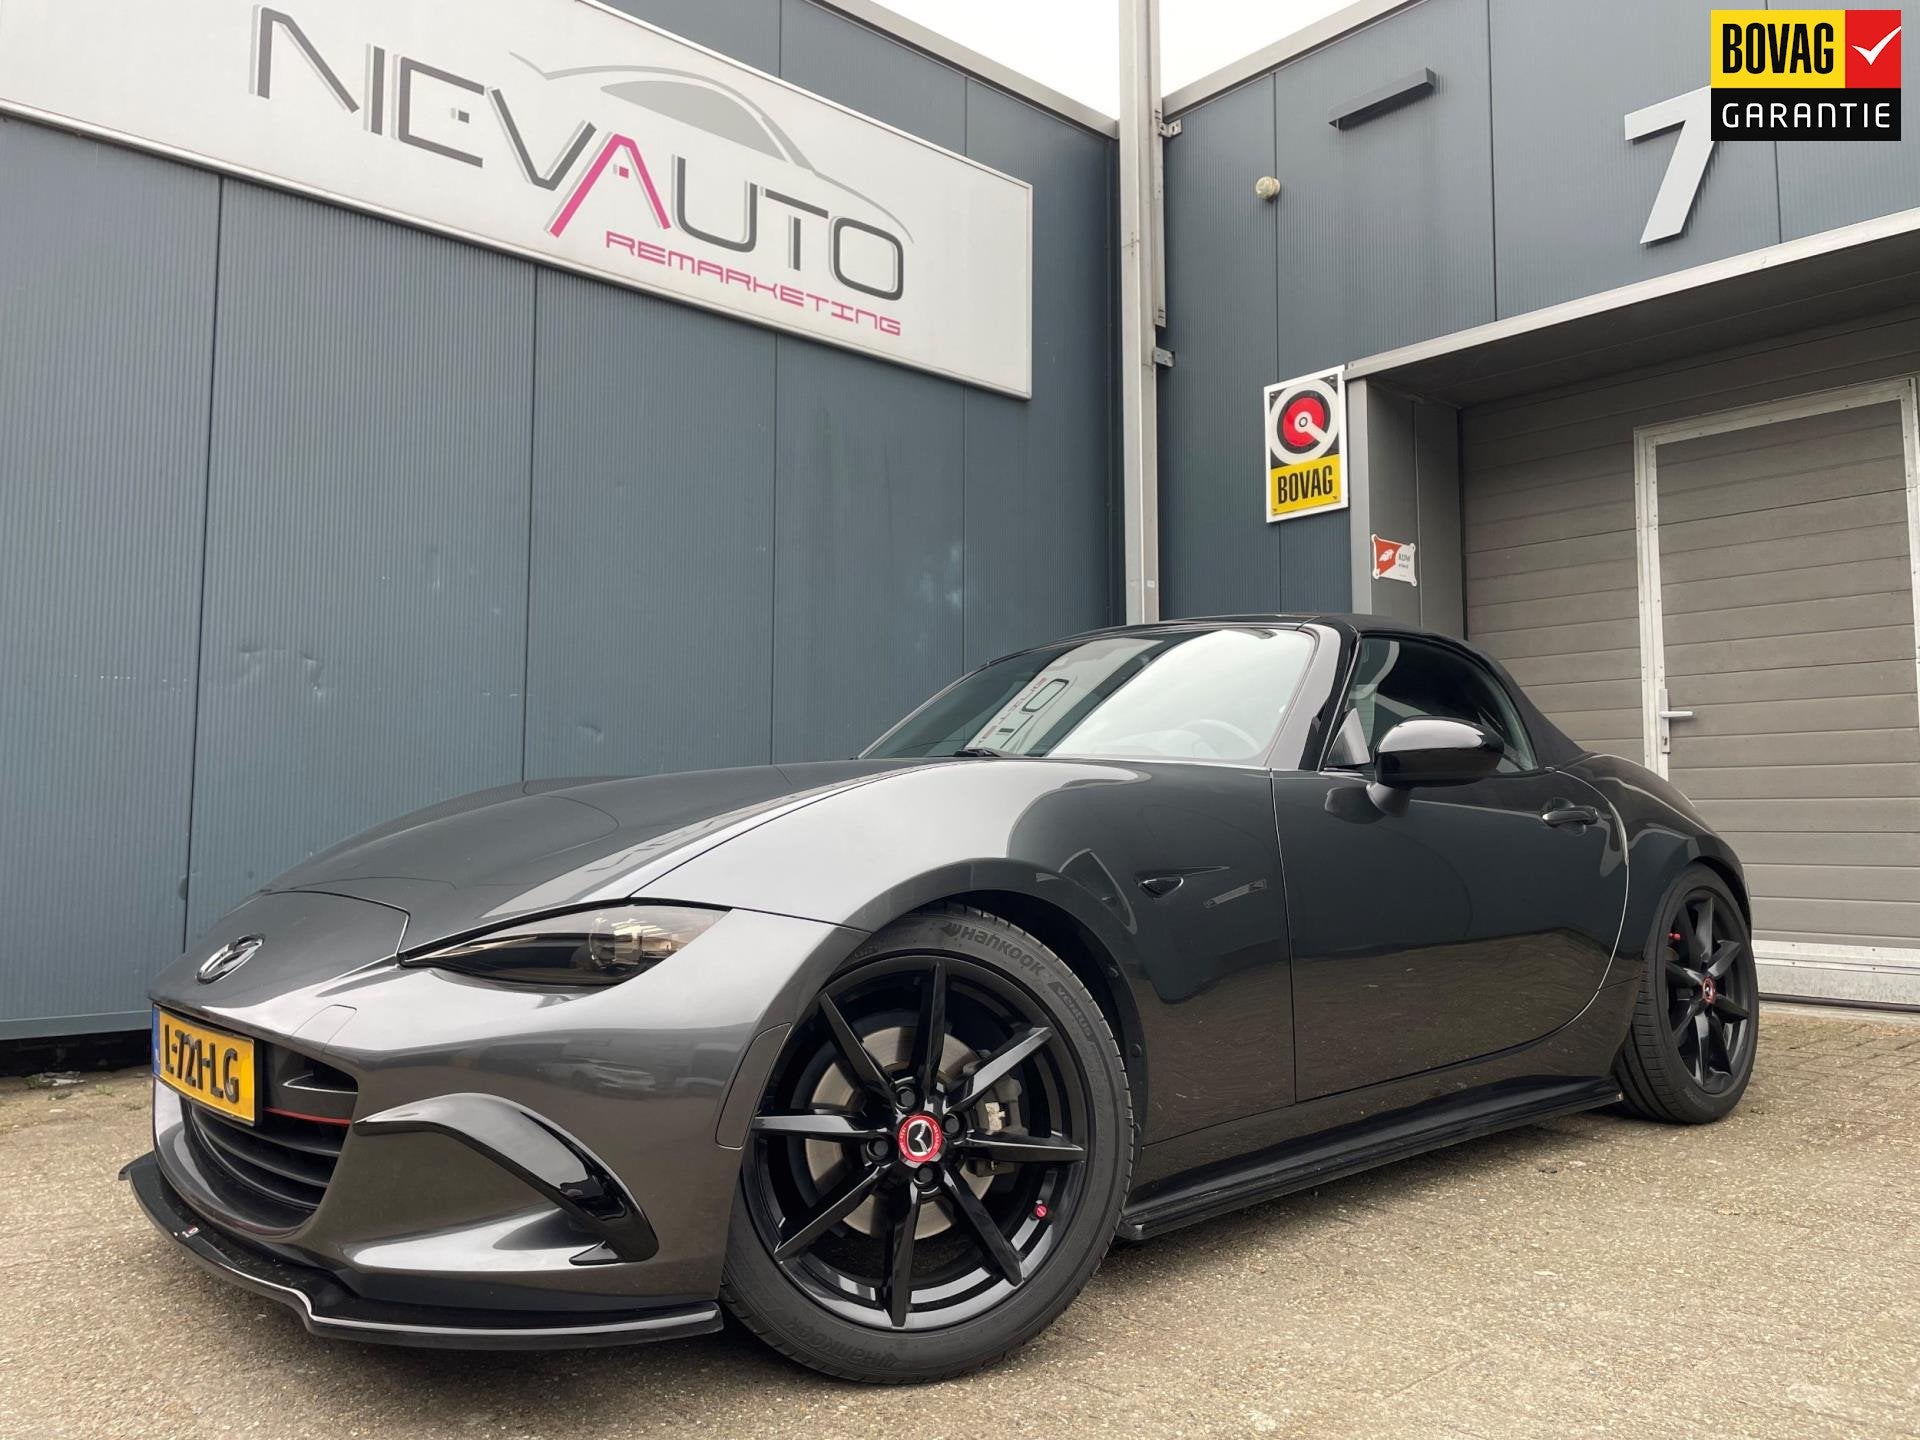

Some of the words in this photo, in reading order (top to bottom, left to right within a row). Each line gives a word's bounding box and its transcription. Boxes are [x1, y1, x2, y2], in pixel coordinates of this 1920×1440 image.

[1624, 85, 1716, 244] 7
[605, 231, 902, 337] REMARKETING
[1277, 465, 1333, 505] BOVAG
[165, 1024, 240, 1104] L-721-LG
